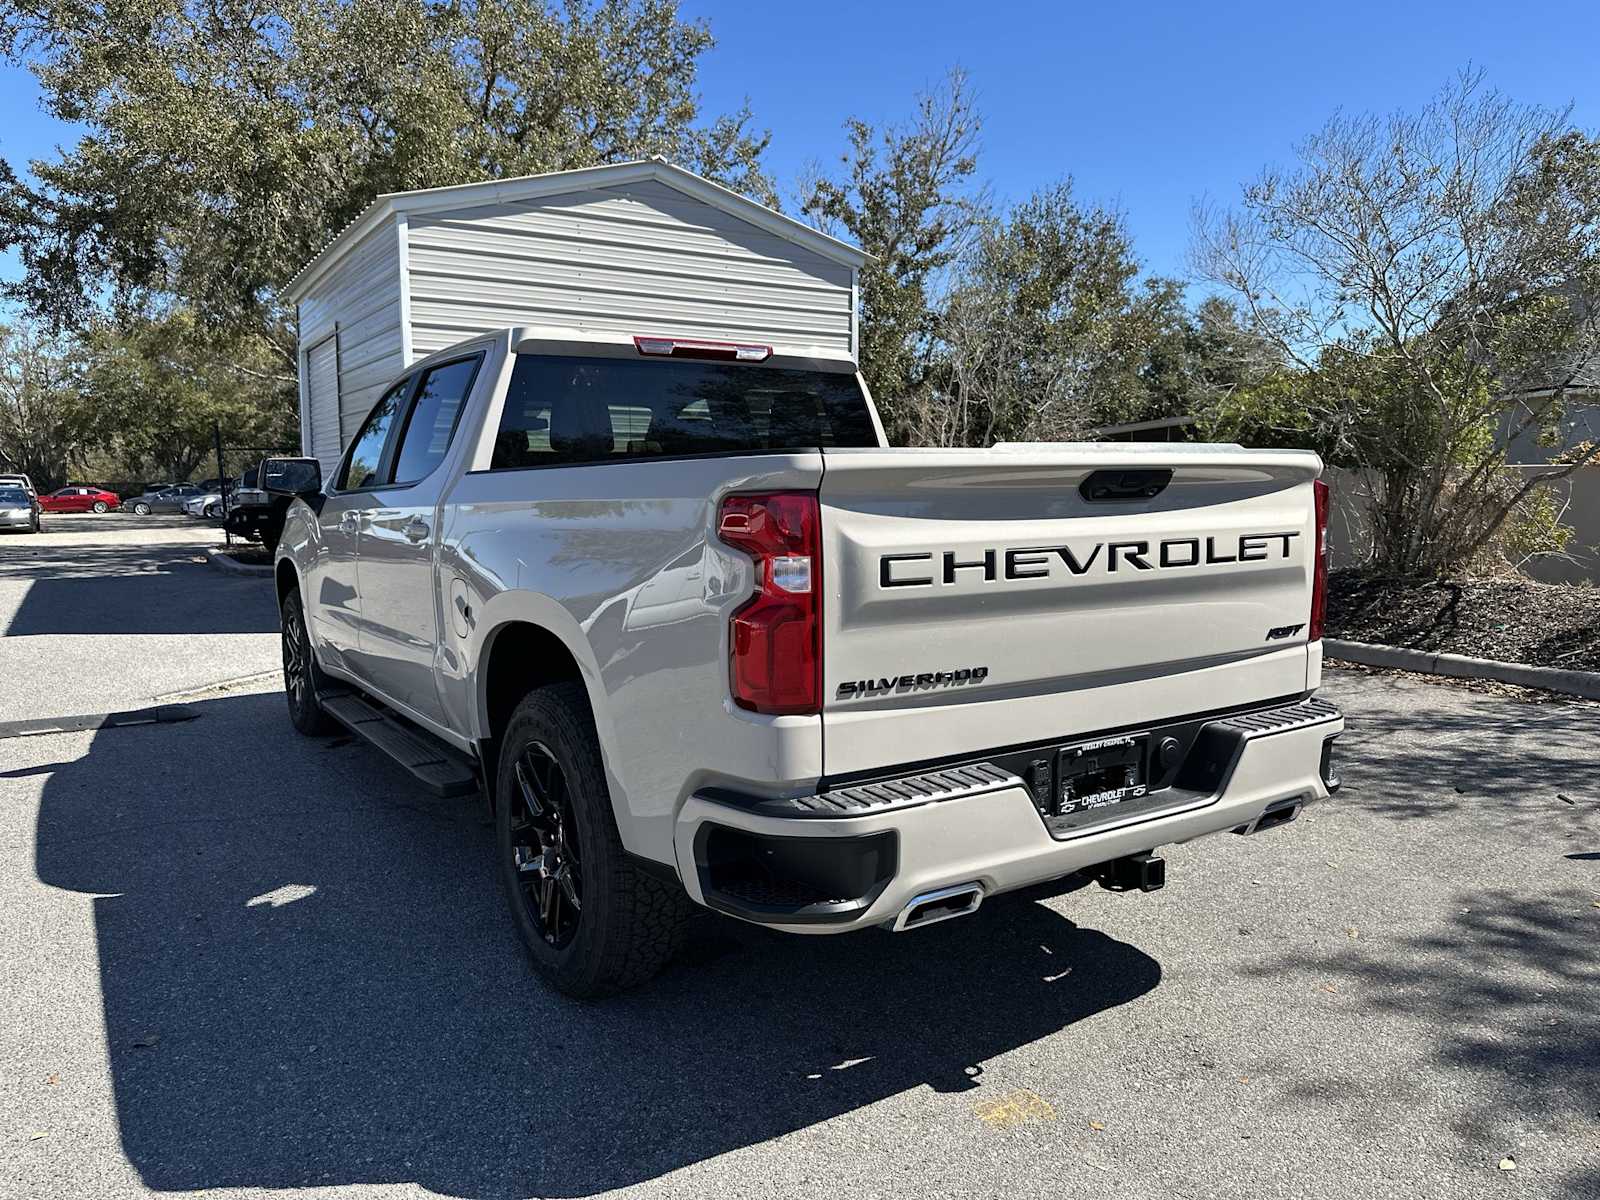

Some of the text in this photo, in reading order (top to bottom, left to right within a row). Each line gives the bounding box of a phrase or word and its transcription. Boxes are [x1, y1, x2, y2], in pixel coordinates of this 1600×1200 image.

[879, 531, 1300, 588] CHEVROLET
[1265, 623, 1307, 642] RST
[838, 667, 989, 695] SILVERADO
[1081, 788, 1126, 806] CHEVROLET
